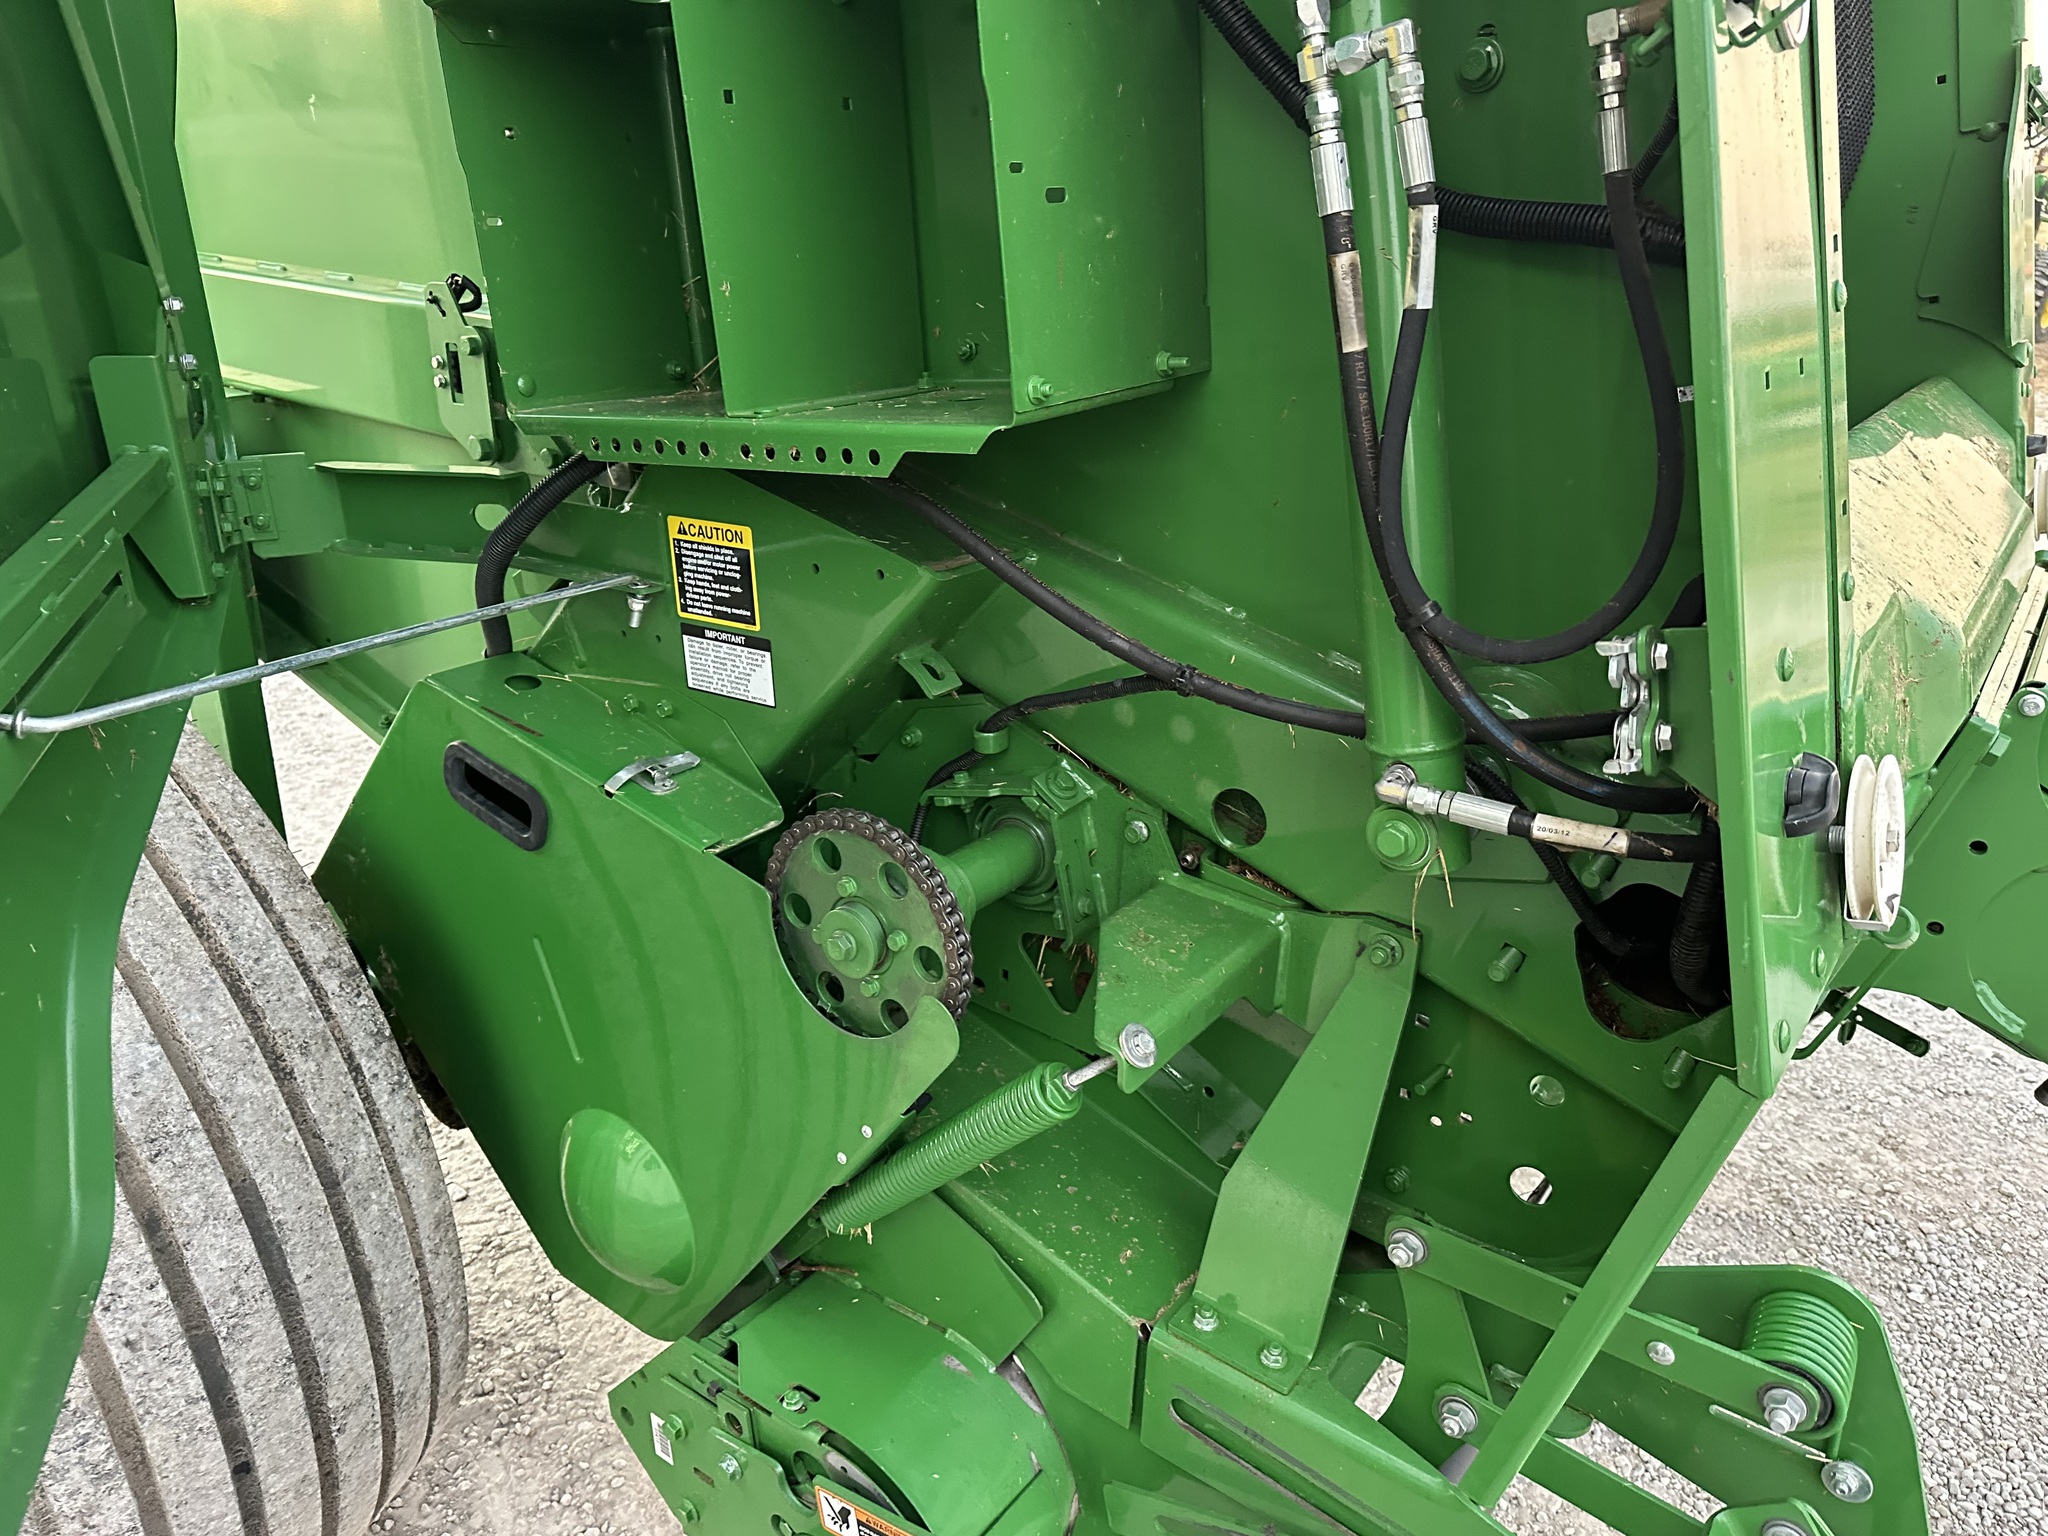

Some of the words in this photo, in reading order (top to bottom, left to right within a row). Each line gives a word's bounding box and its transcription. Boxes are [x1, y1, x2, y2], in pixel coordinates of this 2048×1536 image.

[1358, 392, 1370, 412] SAE
[688, 523, 743, 544] CAUTION
[680, 541, 691, 549] Keep
[698, 544, 714, 552] shields
[681, 548, 704, 558] Disengage
[697, 566, 718, 576] servicing
[684, 577, 695, 586] Keep
[686, 592, 700, 600] driven
[693, 587, 704, 595] away
[714, 604, 731, 614] running
[732, 608, 751, 616] machine
[704, 629, 746, 645] IMPORTANT
[687, 637, 704, 645] Damage
[747, 650, 766, 658] bearings
[1427, 640, 1444, 661] SHA
[689, 649, 711, 658] installation
[726, 679, 748, 688] tightening
[734, 676, 750, 684] bearing
[726, 690, 749, 699] performing
[1536, 825, 1570, 836] 20/03/12
